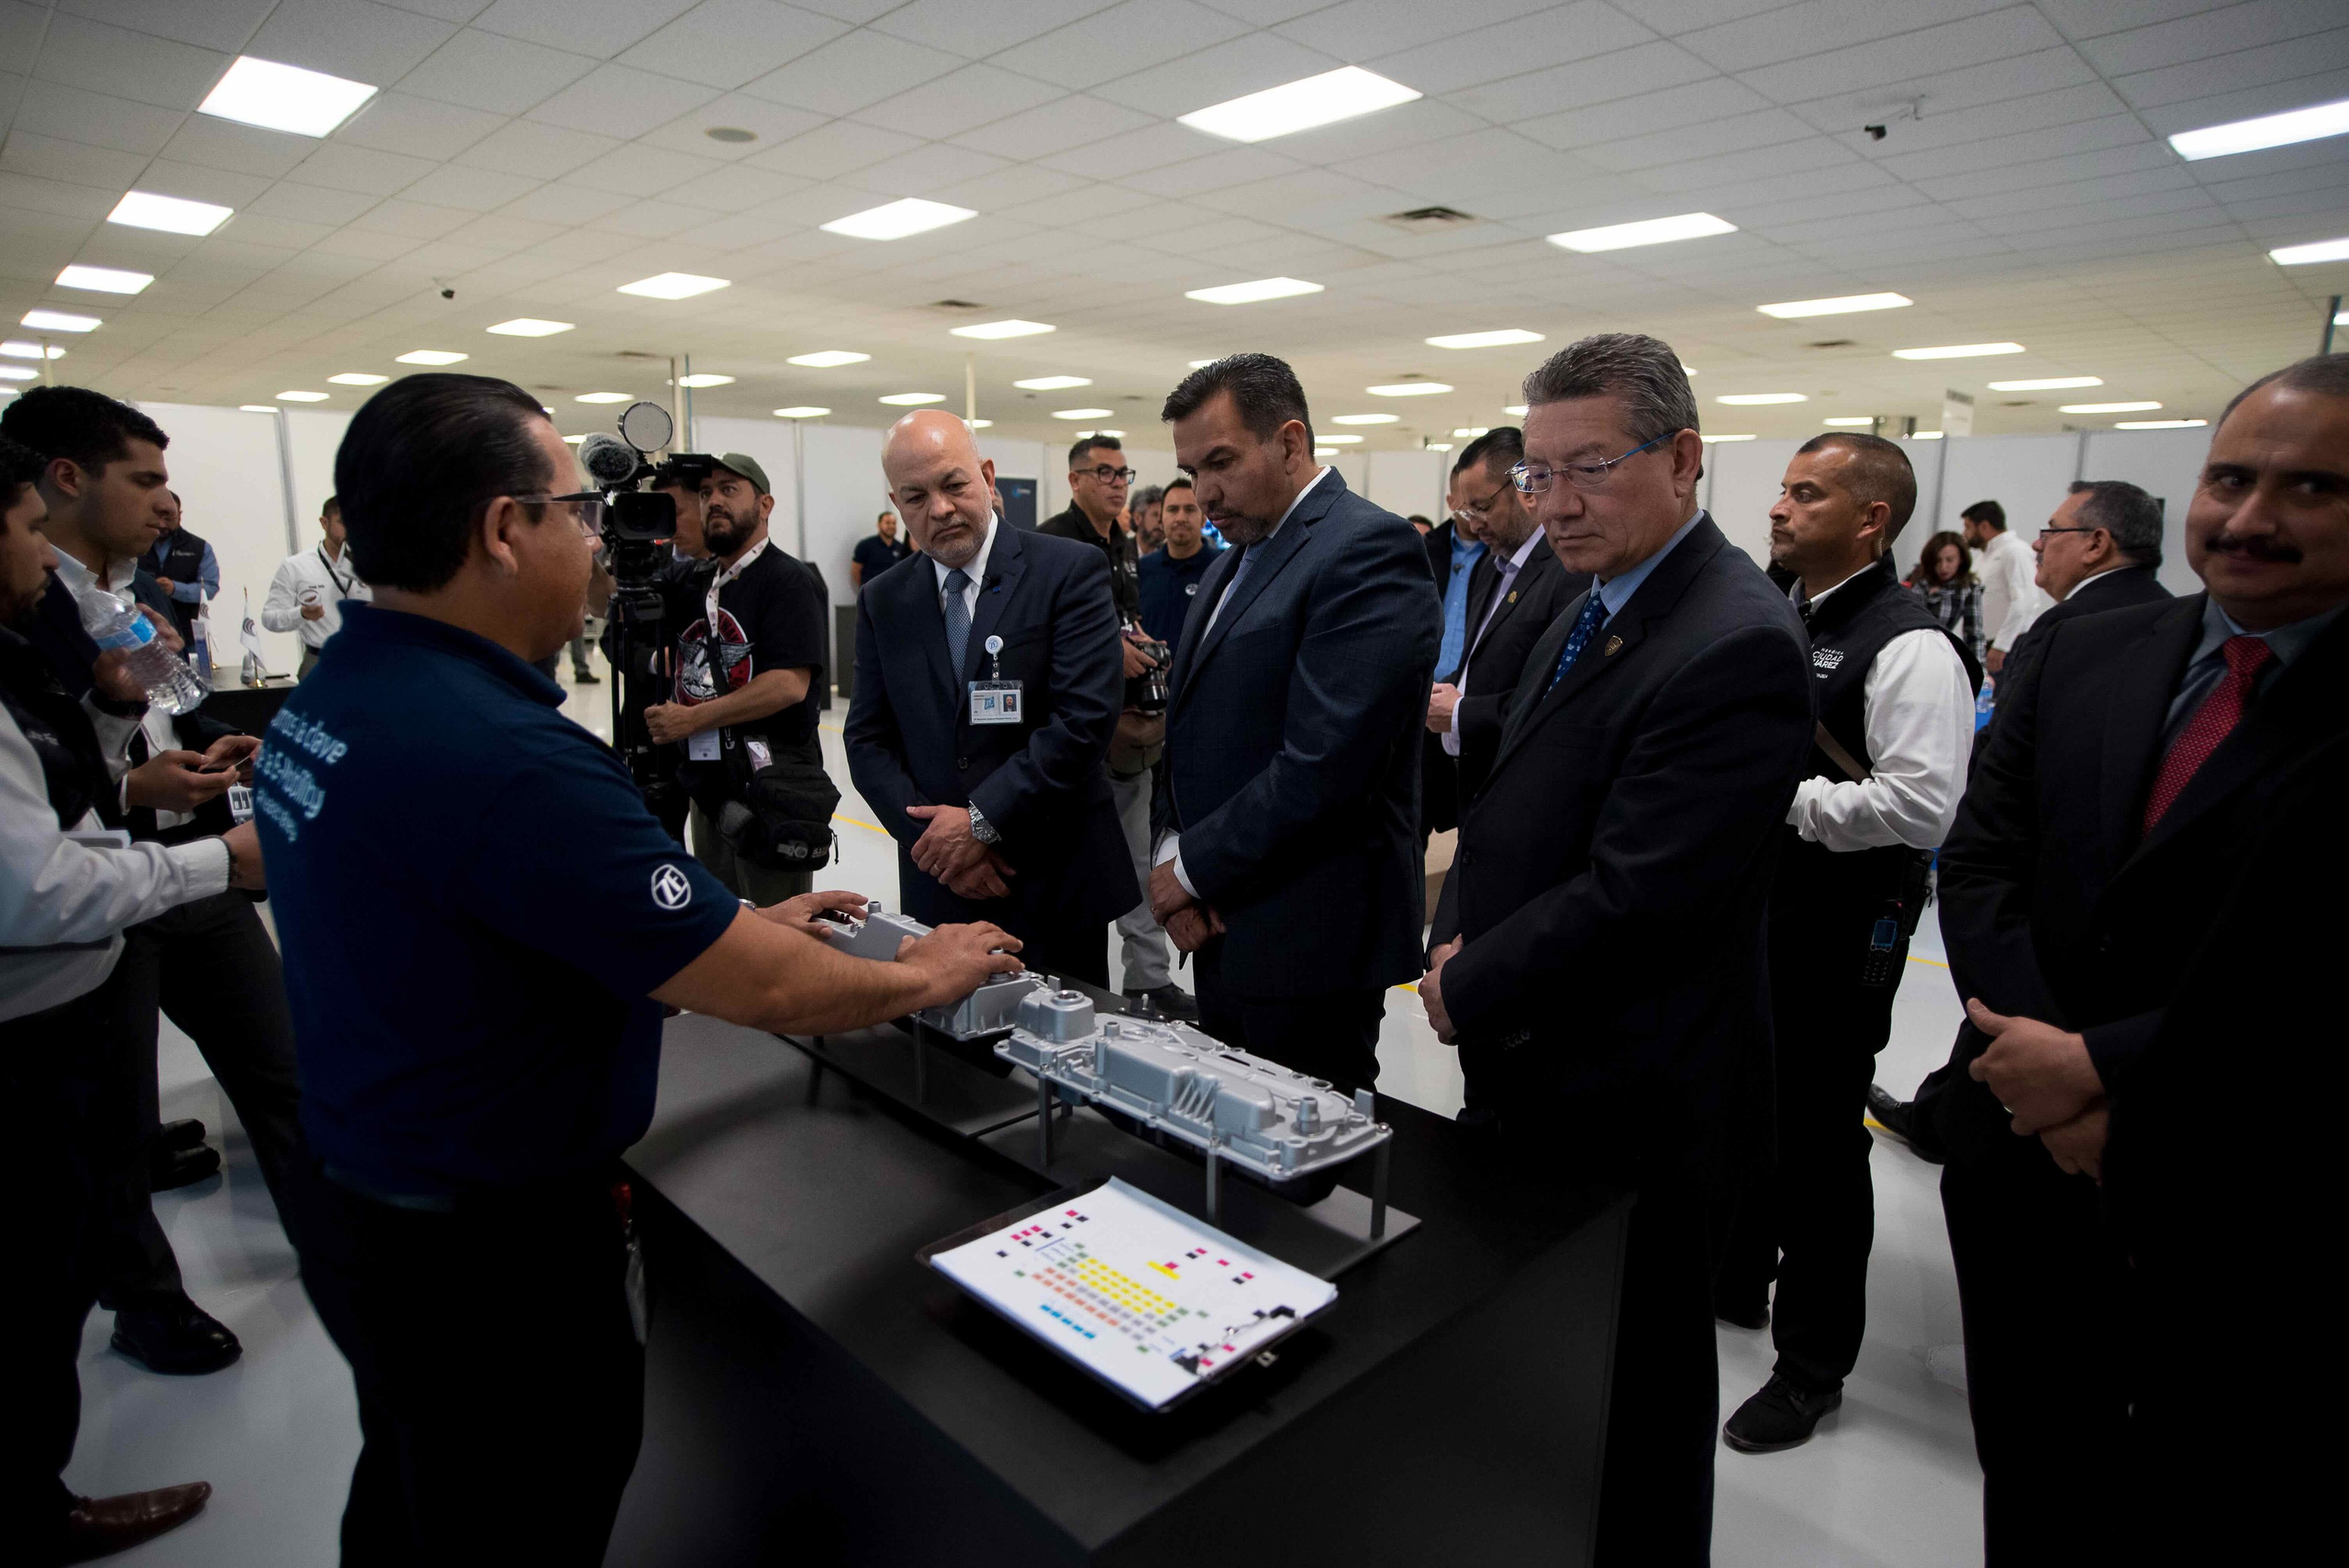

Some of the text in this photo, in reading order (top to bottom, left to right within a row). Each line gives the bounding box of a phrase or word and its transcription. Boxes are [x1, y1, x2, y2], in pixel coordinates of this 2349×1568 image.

[1812, 651, 1844, 662] CIUDAD
[303, 719, 348, 764] clave
[651, 863, 692, 910] ZF
